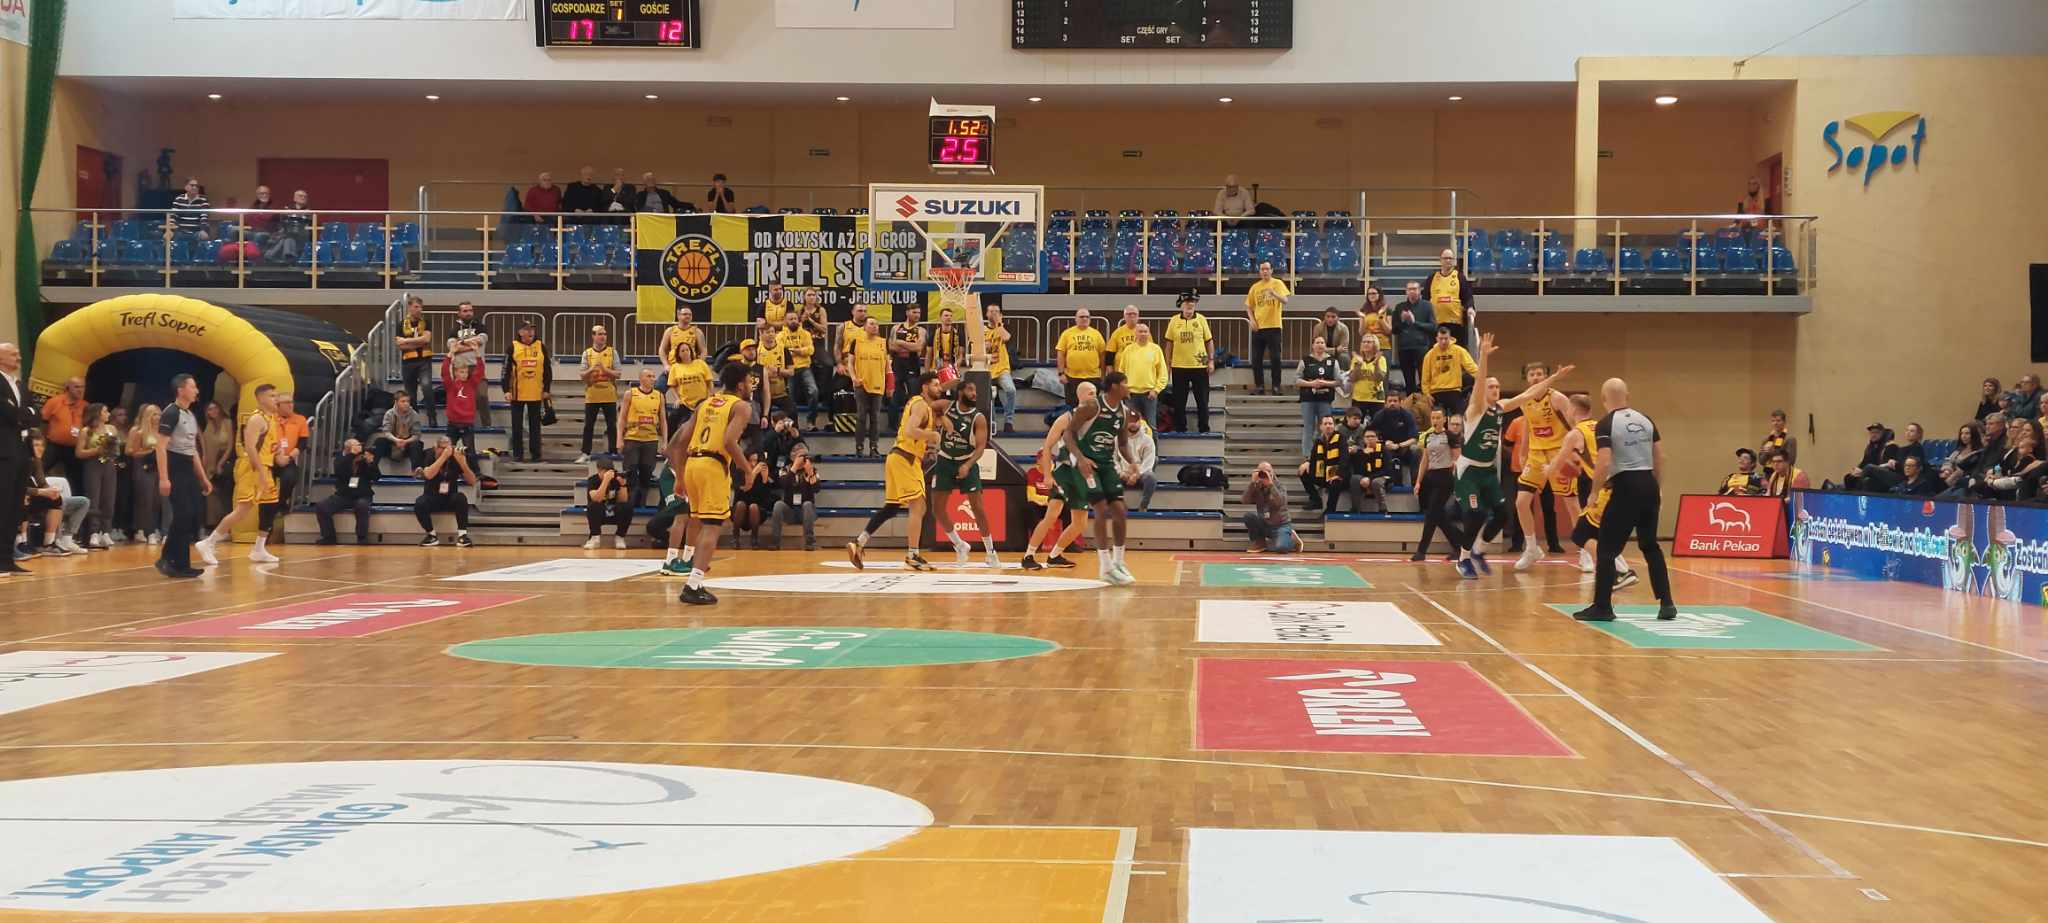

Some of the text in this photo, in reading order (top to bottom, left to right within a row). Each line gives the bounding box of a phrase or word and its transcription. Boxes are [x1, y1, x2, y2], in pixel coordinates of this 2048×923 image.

[552, 3, 606, 14] GOSPODARZE
[640, 3, 670, 15] GOŚCIE
[1250, 9, 1260, 17] 12
[1063, 17, 1069, 25] 2
[1201, 17, 1208, 25] 2
[570, 20, 593, 40] 17
[658, 20, 683, 41] 12
[1015, 36, 1025, 44] 15
[1120, 35, 1136, 44] SET
[1165, 35, 1181, 44] SET
[1250, 35, 1259, 44] 15
[940, 138, 979, 162] 2.5
[1823, 117, 1927, 188] Sopot
[924, 199, 1020, 216] SUZUKI
[754, 228, 917, 249] OD KOŁYSKI AŻ P GRÓB
[666, 239, 720, 266] TREFL
[743, 251, 827, 287] TREFL
[670, 276, 718, 297] SOPOT
[754, 290, 791, 304] JEO
[794, 290, 837, 304] MSTO
[849, 290, 884, 304] JEDEN
[888, 290, 917, 304] KLUB
[120, 311, 207, 337] Trefl Sopot
[701, 426, 711, 444] 0
[960, 422, 967, 433] 7
[1690, 539, 1760, 552] Bank Pekao
[1296, 688, 1433, 736] ORLEN
[9, 783, 377, 899] WALESA AIRPORT
[104, 802, 408, 902] GDANSK LECH
